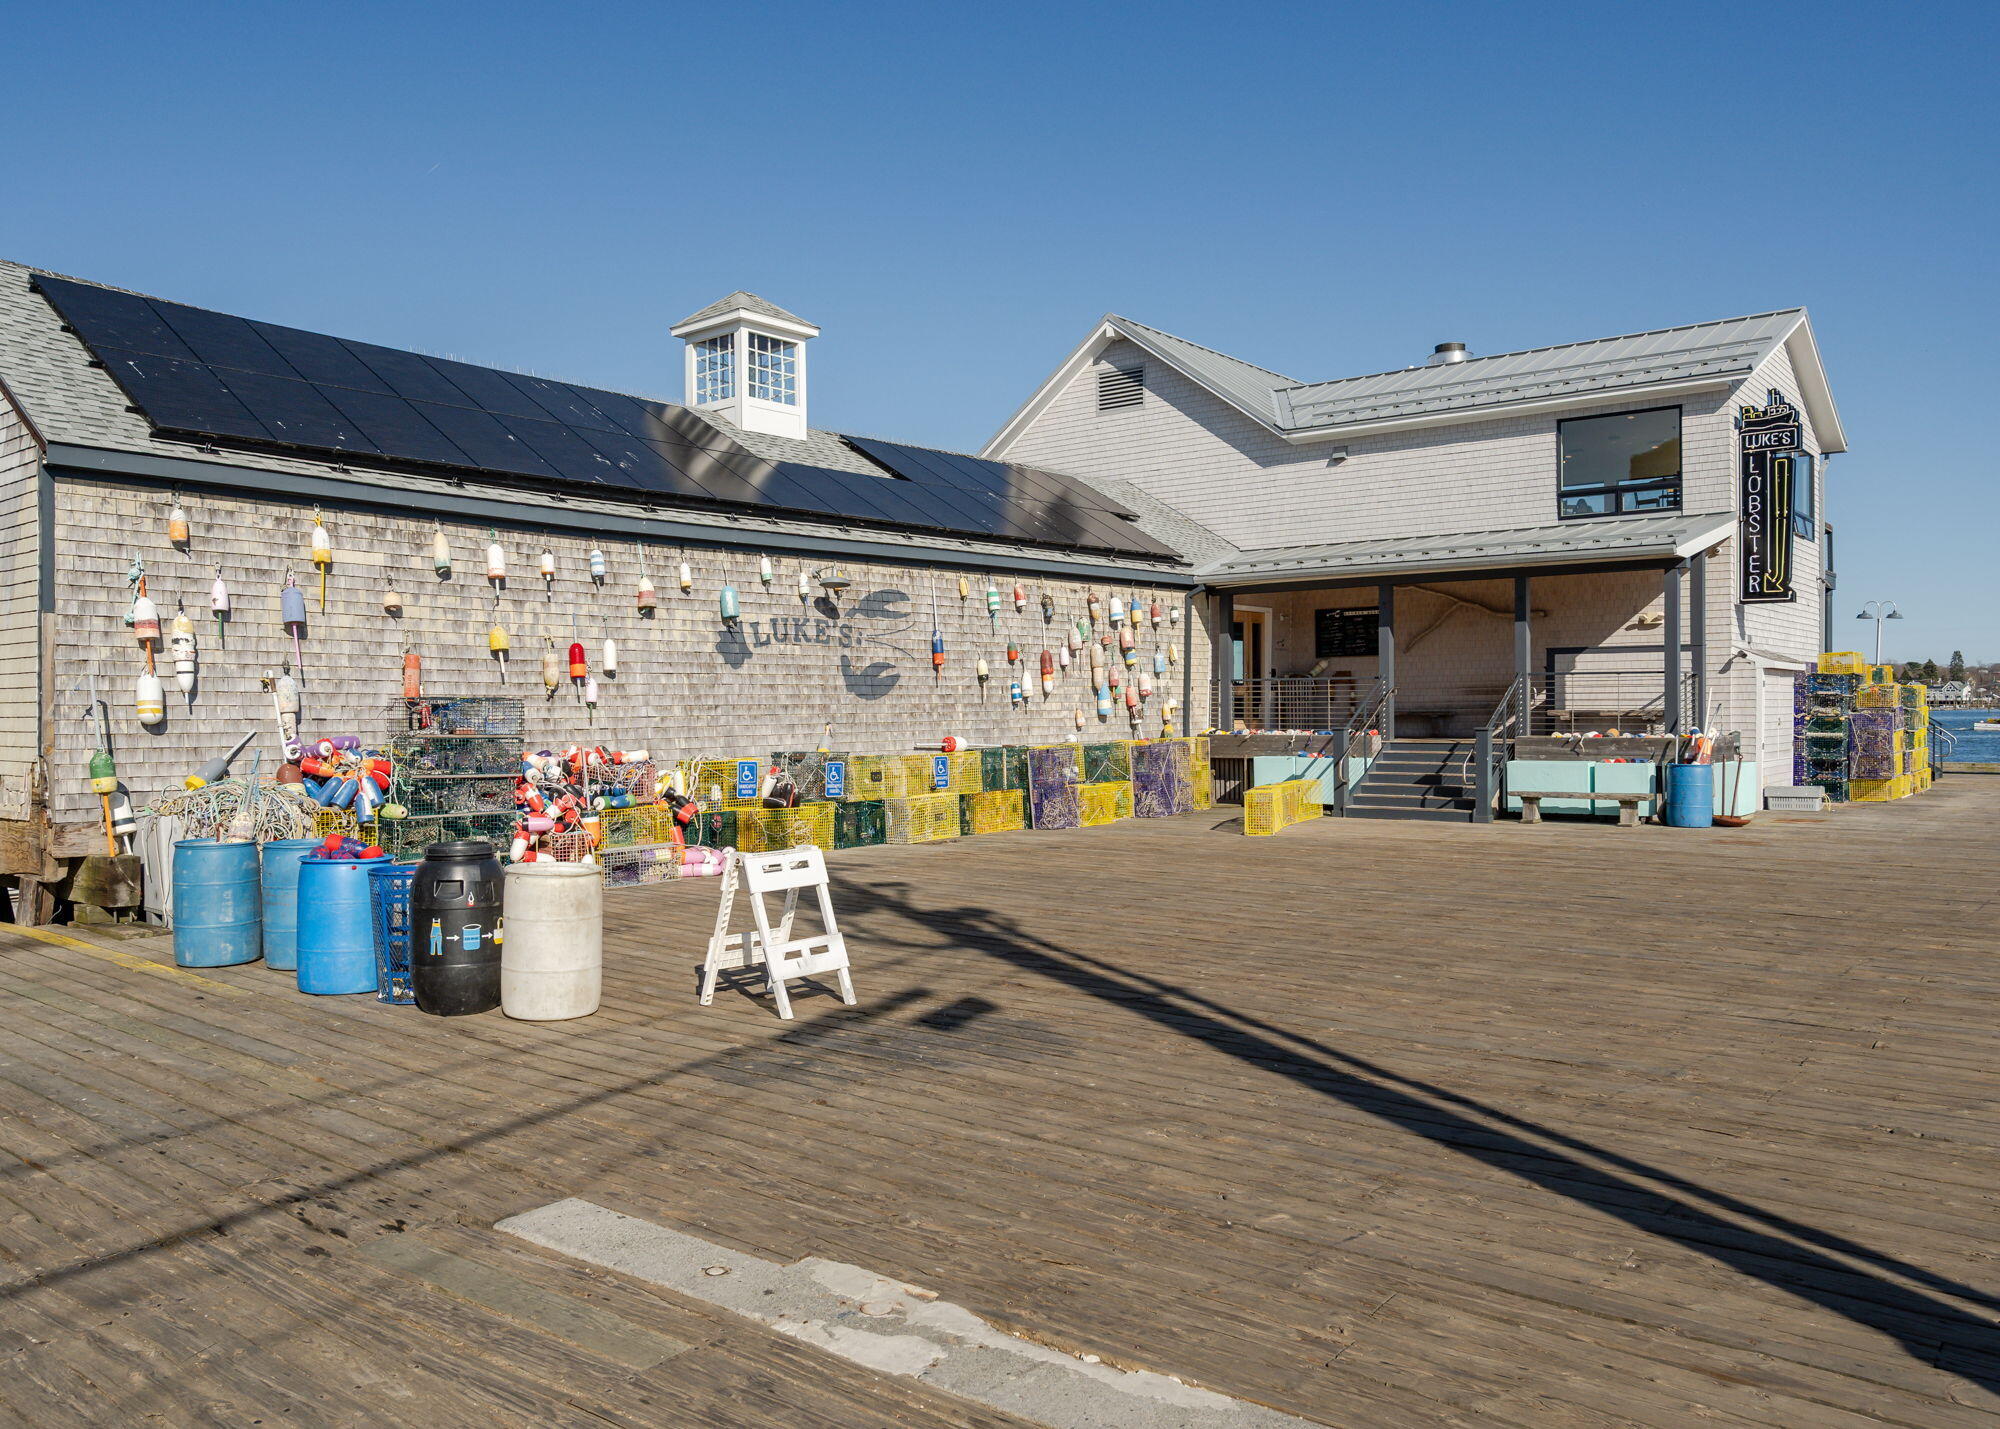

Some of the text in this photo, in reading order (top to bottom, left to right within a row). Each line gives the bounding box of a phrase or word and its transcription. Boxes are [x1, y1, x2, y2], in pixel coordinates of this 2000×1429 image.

[1745, 432, 1791, 448] LUKE'S
[1748, 456, 1762, 593] LOBSTER
[749, 617, 853, 648] LUKE'S
